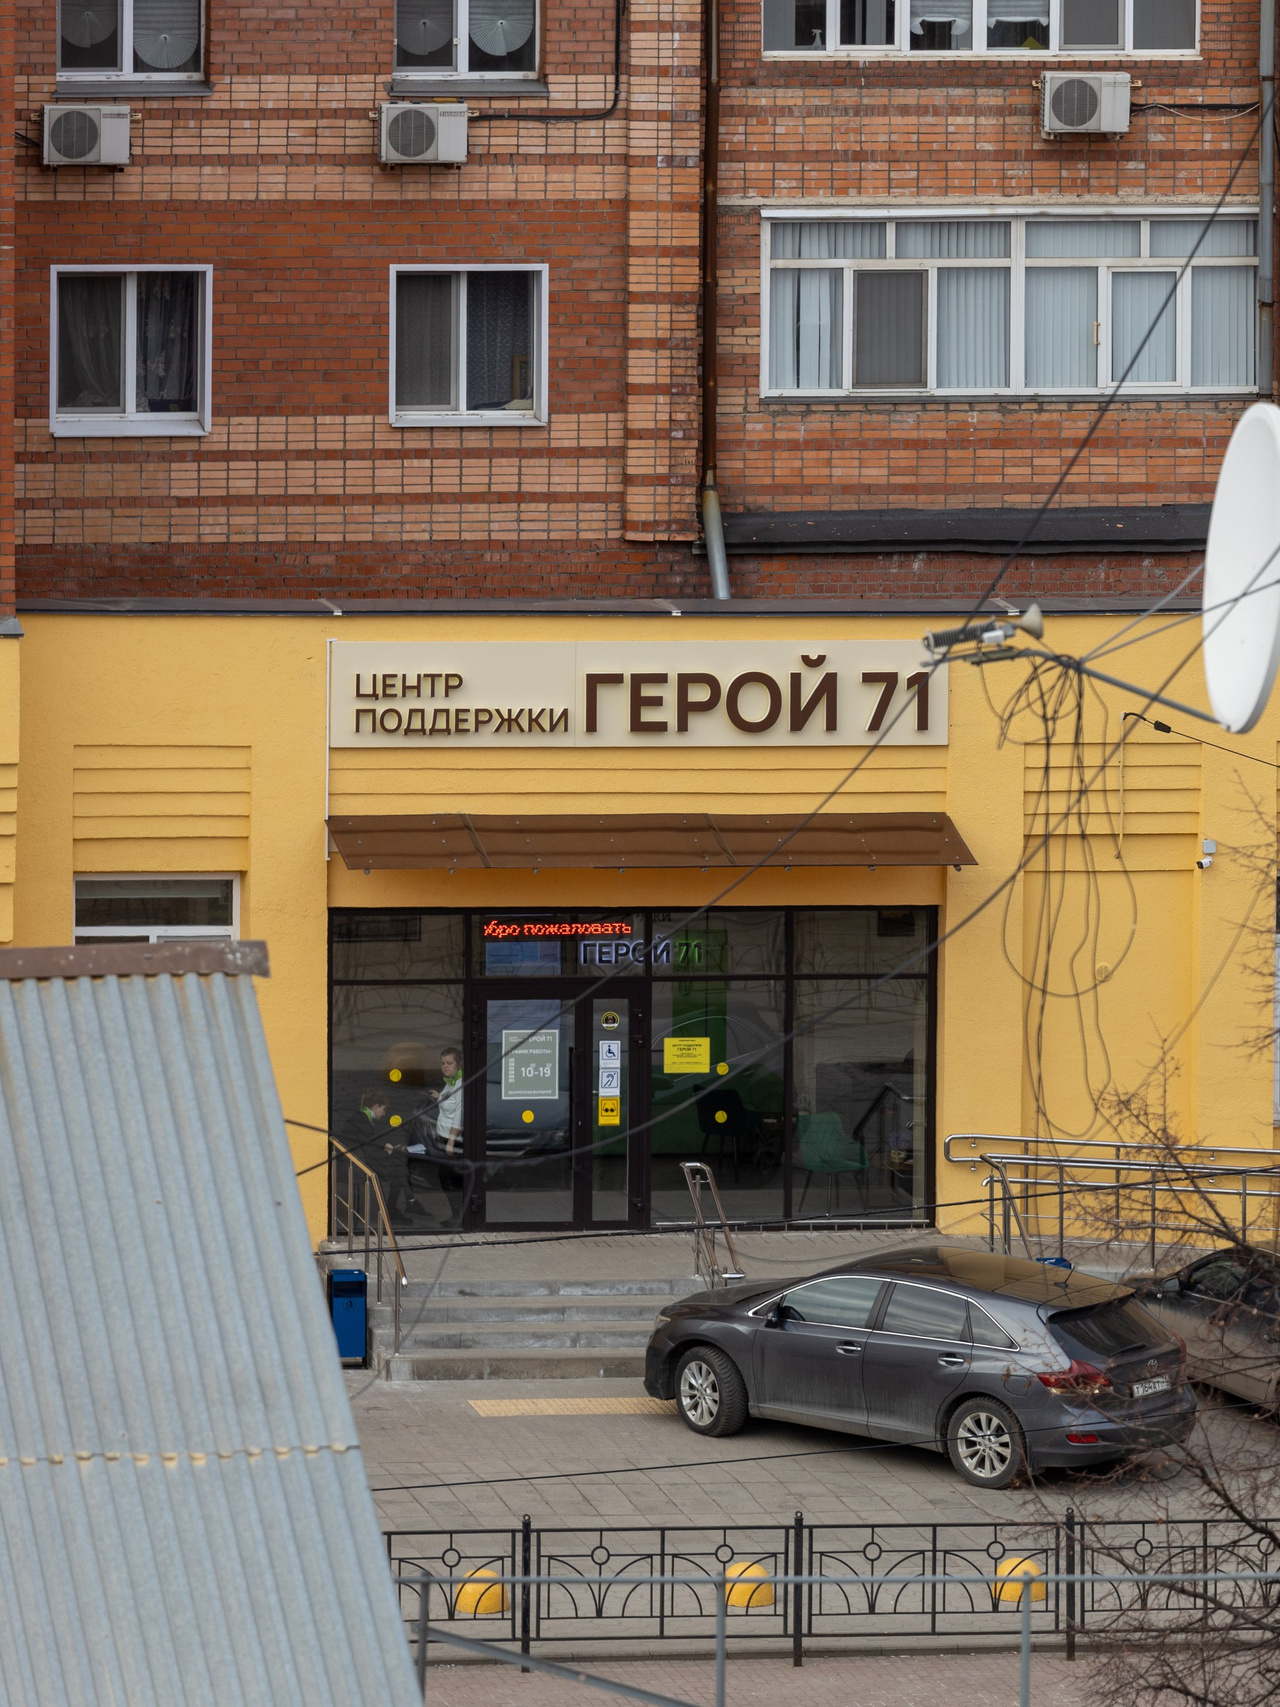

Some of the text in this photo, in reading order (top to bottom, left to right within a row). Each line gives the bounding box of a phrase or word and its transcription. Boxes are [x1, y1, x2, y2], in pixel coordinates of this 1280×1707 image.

[354, 673, 463, 699] ЦЕНТР
[585, 654, 930, 733] ГЕРОЙ 71
[354, 707, 569, 736] ПОДДЕРЖКИ
[678, 941, 702, 964] 71
